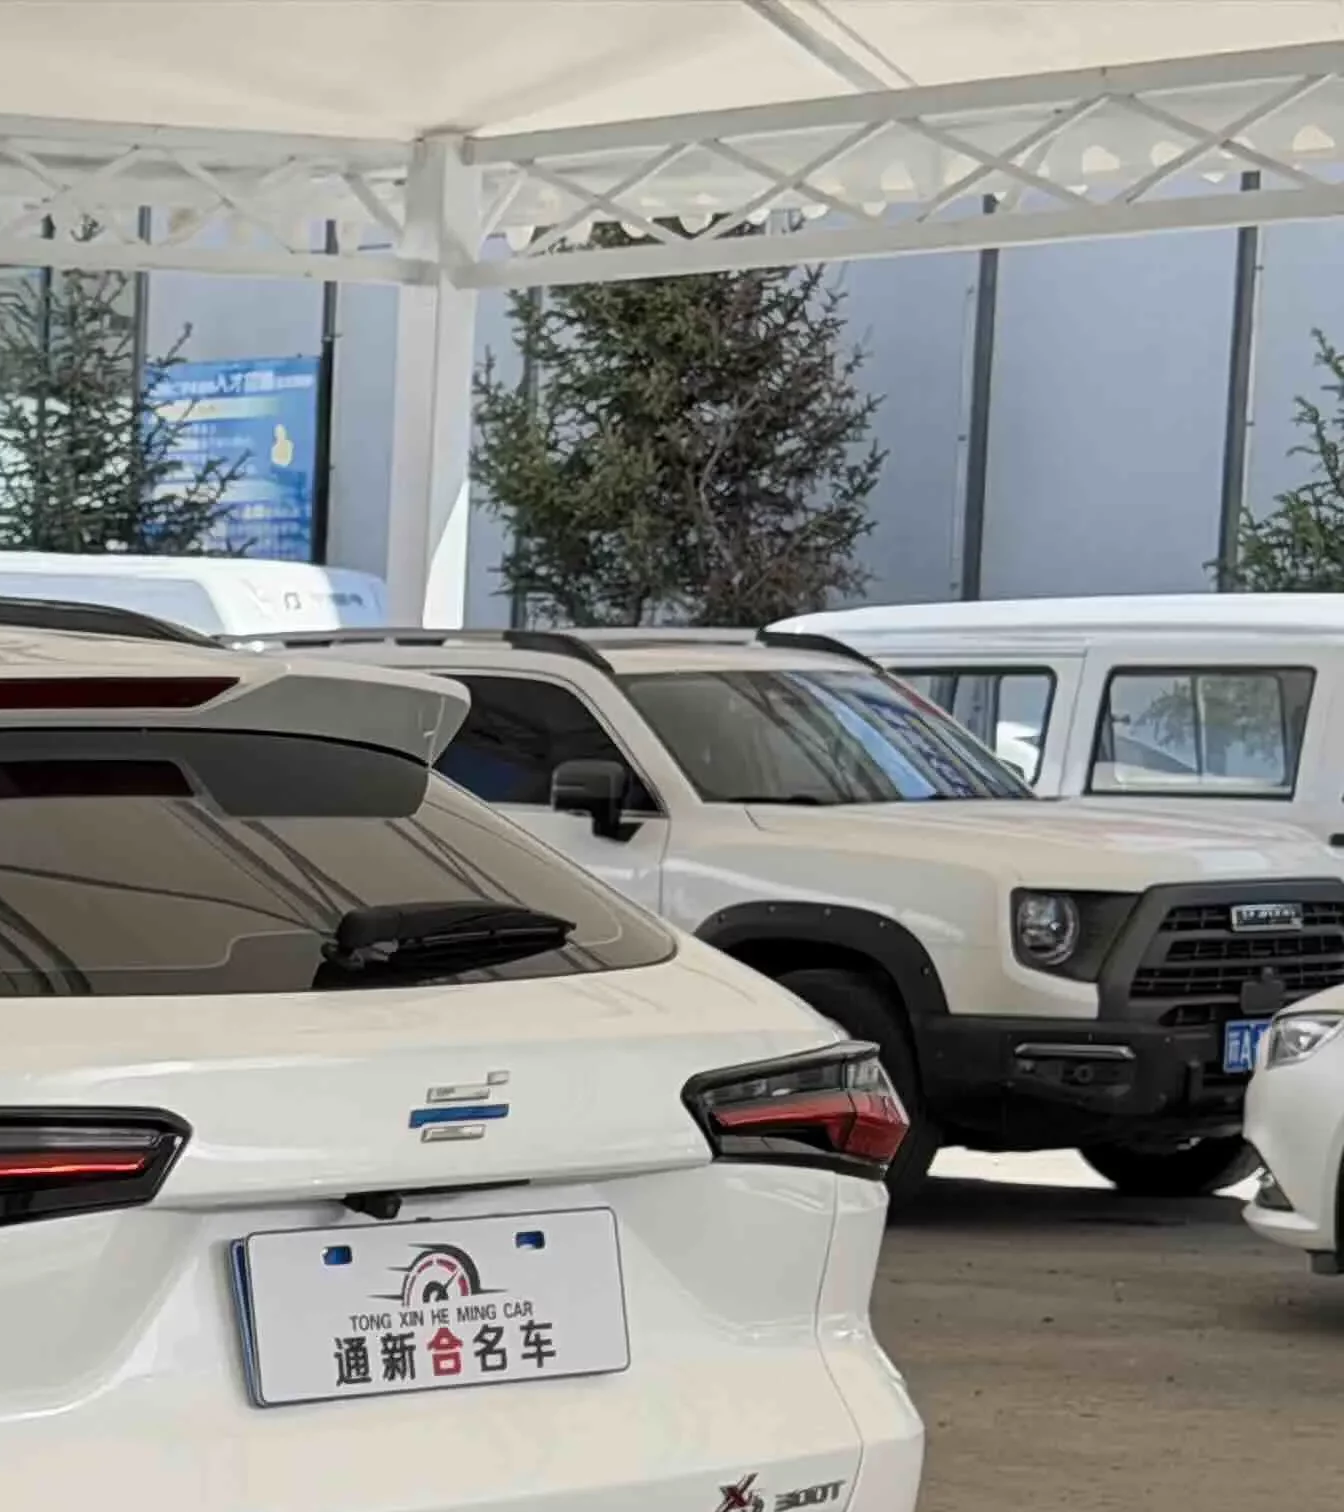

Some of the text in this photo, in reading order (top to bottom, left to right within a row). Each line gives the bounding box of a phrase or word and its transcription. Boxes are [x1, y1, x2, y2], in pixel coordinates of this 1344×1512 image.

[349, 1300, 534, 1332] TONG XIN HE MING CAR
[333, 1319, 556, 1387] 通新合名车
